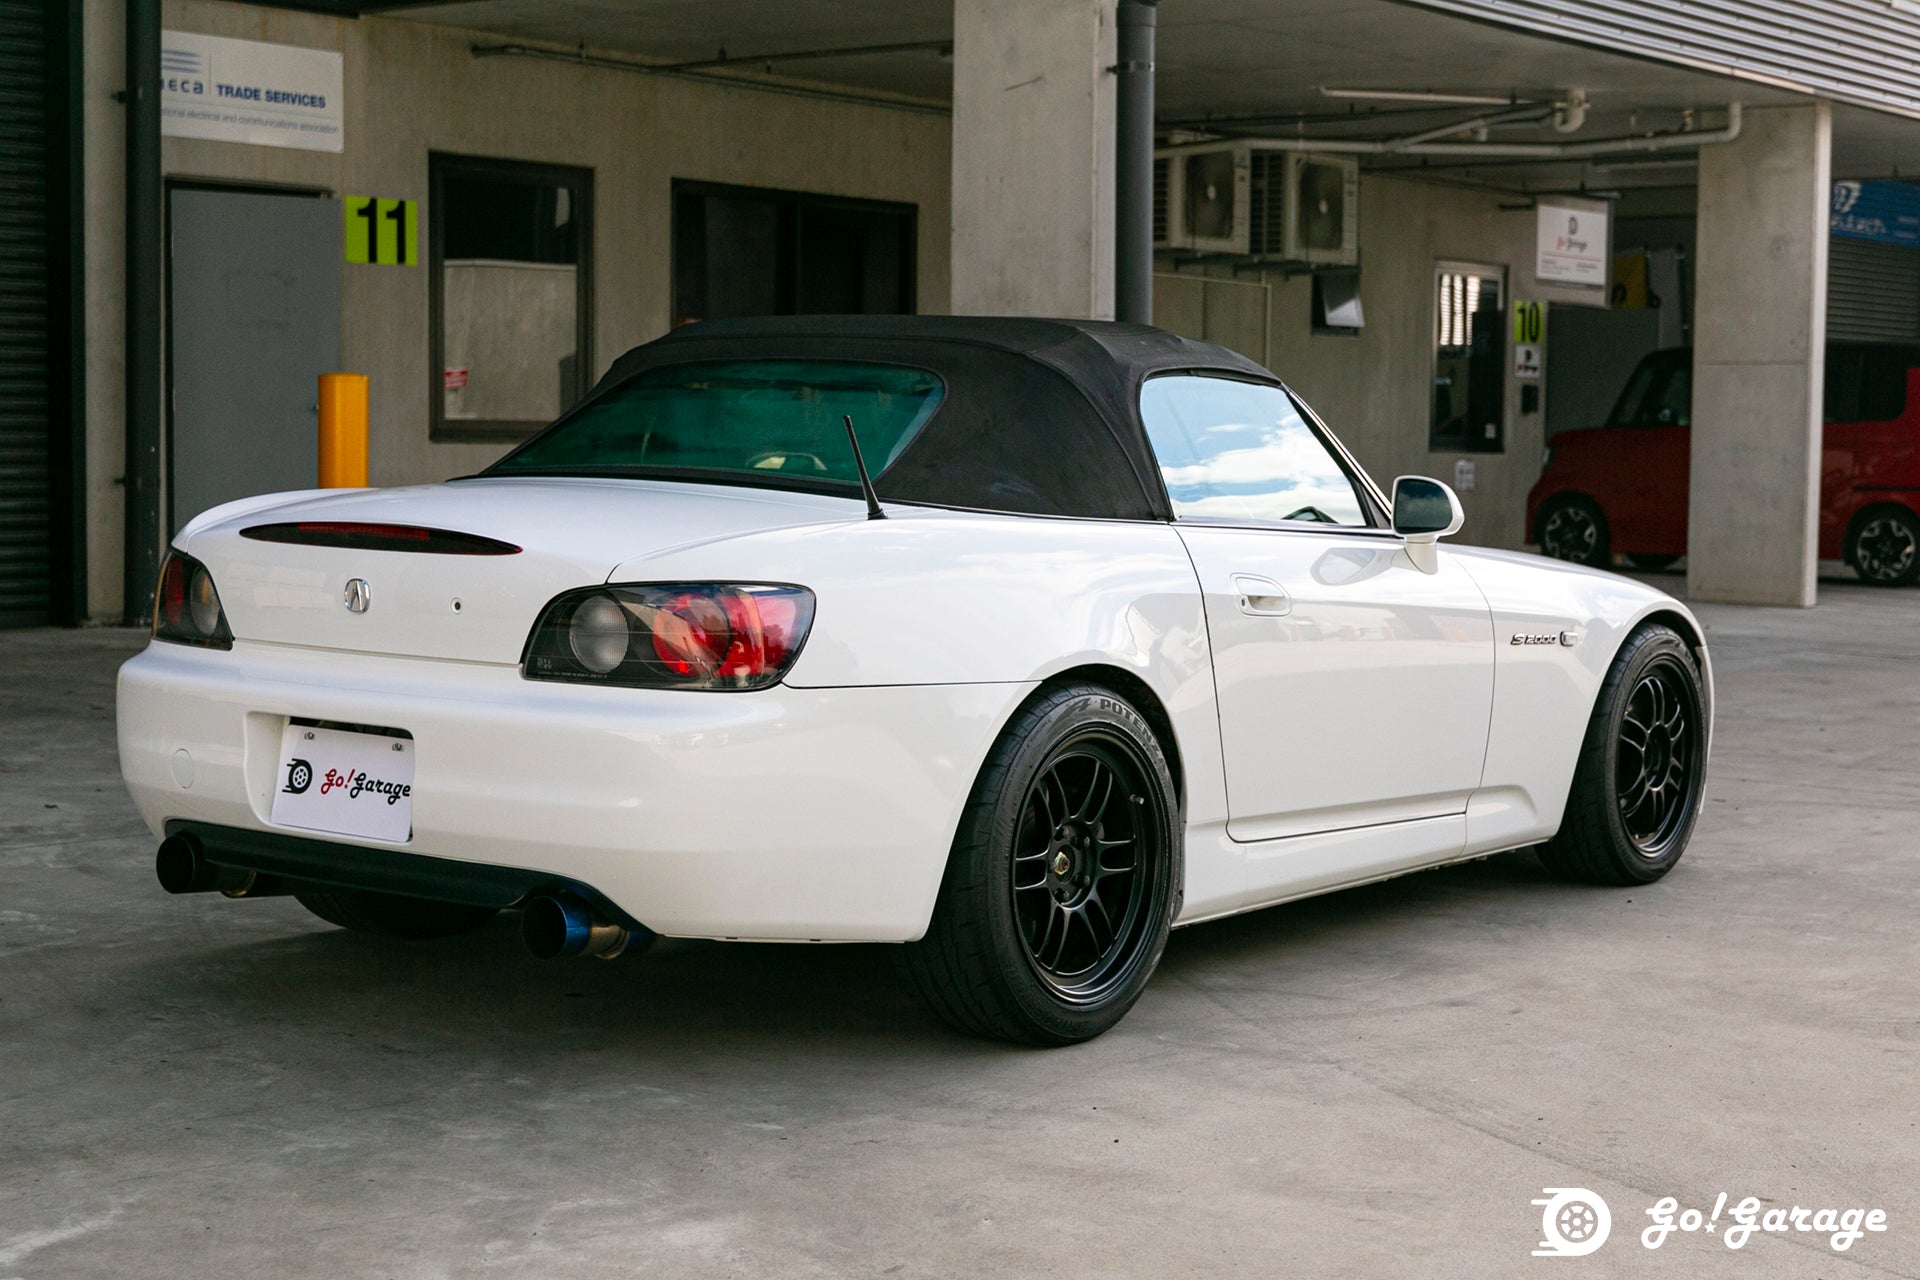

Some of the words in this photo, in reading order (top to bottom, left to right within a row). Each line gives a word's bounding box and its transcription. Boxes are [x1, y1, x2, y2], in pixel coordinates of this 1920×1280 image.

[216, 84, 261, 101] TRADE
[265, 89, 326, 109] SERVICES
[357, 197, 406, 264] 11
[1518, 302, 1540, 342] 10
[1510, 632, 1557, 646] S2000
